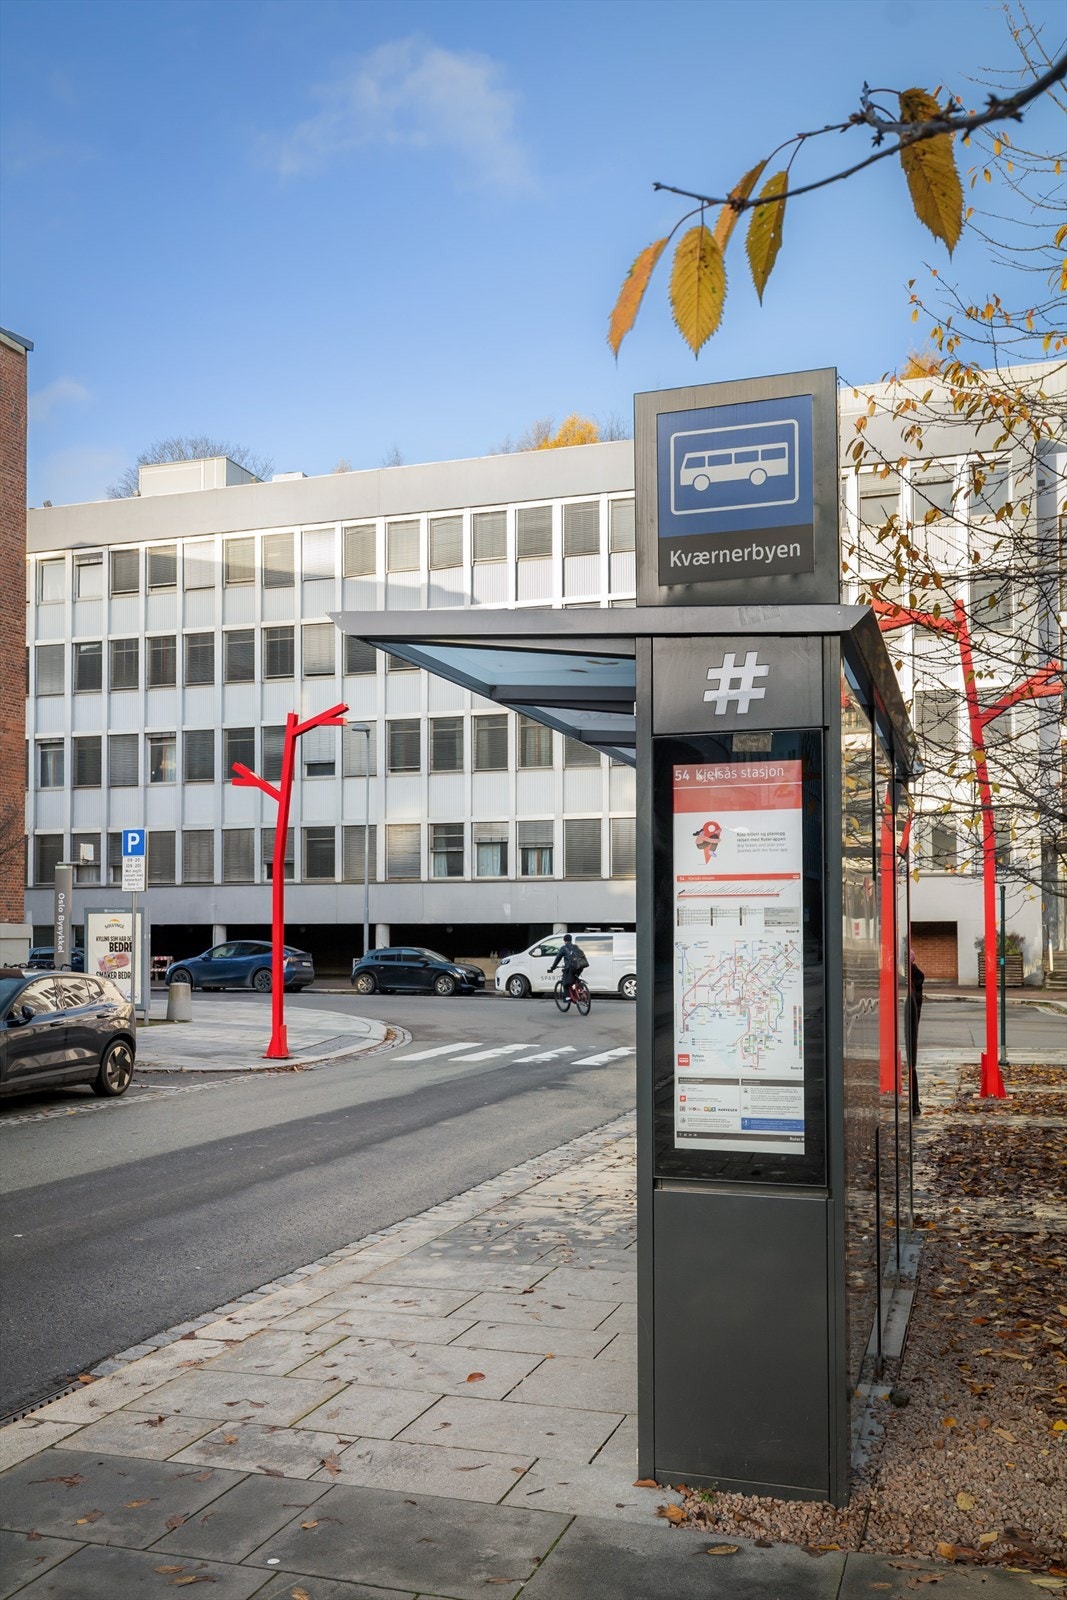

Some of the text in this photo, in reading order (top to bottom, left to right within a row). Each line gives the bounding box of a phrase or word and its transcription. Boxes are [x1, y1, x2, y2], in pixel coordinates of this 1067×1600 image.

[670, 542, 801, 568] Kværnerbyen
[674, 766, 784, 782] 54 Kjelsås stasjon
[128, 832, 140, 853] P
[56, 893, 65, 953] Oslo Bysykkel
